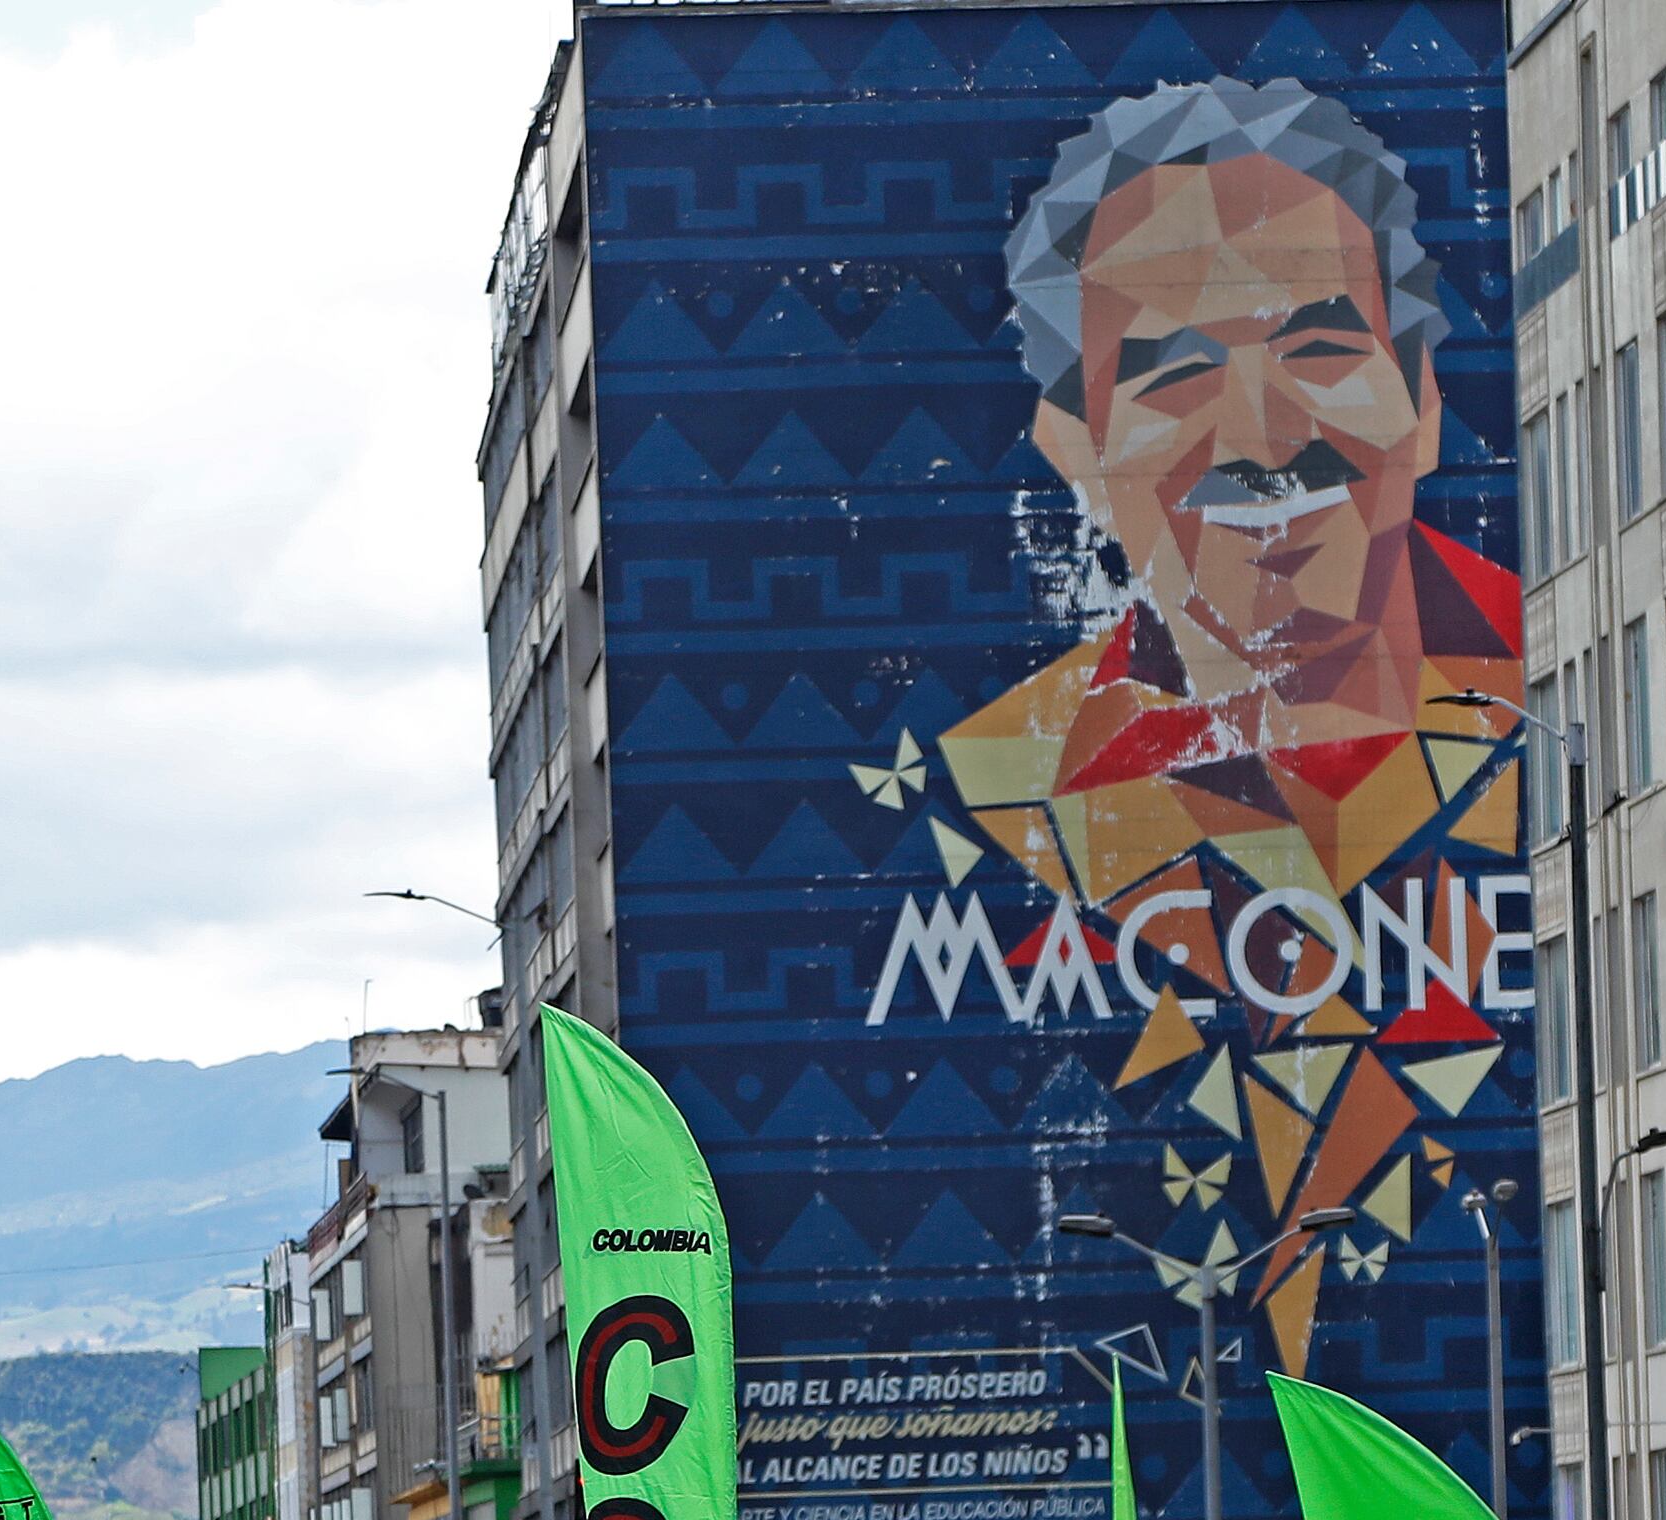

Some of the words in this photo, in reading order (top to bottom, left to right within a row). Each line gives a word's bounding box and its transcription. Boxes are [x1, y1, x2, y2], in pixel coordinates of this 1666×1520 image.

[590, 1228, 713, 1255] COLOMBIA
[743, 1380, 796, 1408] POR
[802, 1379, 834, 1406] EL
[839, 1370, 902, 1404] PAÍS
[910, 1367, 1048, 1402] PRÓSPERO
[827, 1410, 899, 1452] que
[761, 1452, 883, 1484] ALCANCE
[888, 1453, 924, 1481] DE
[927, 1451, 977, 1478] LOS
[982, 1444, 1070, 1477] NIÑOS
